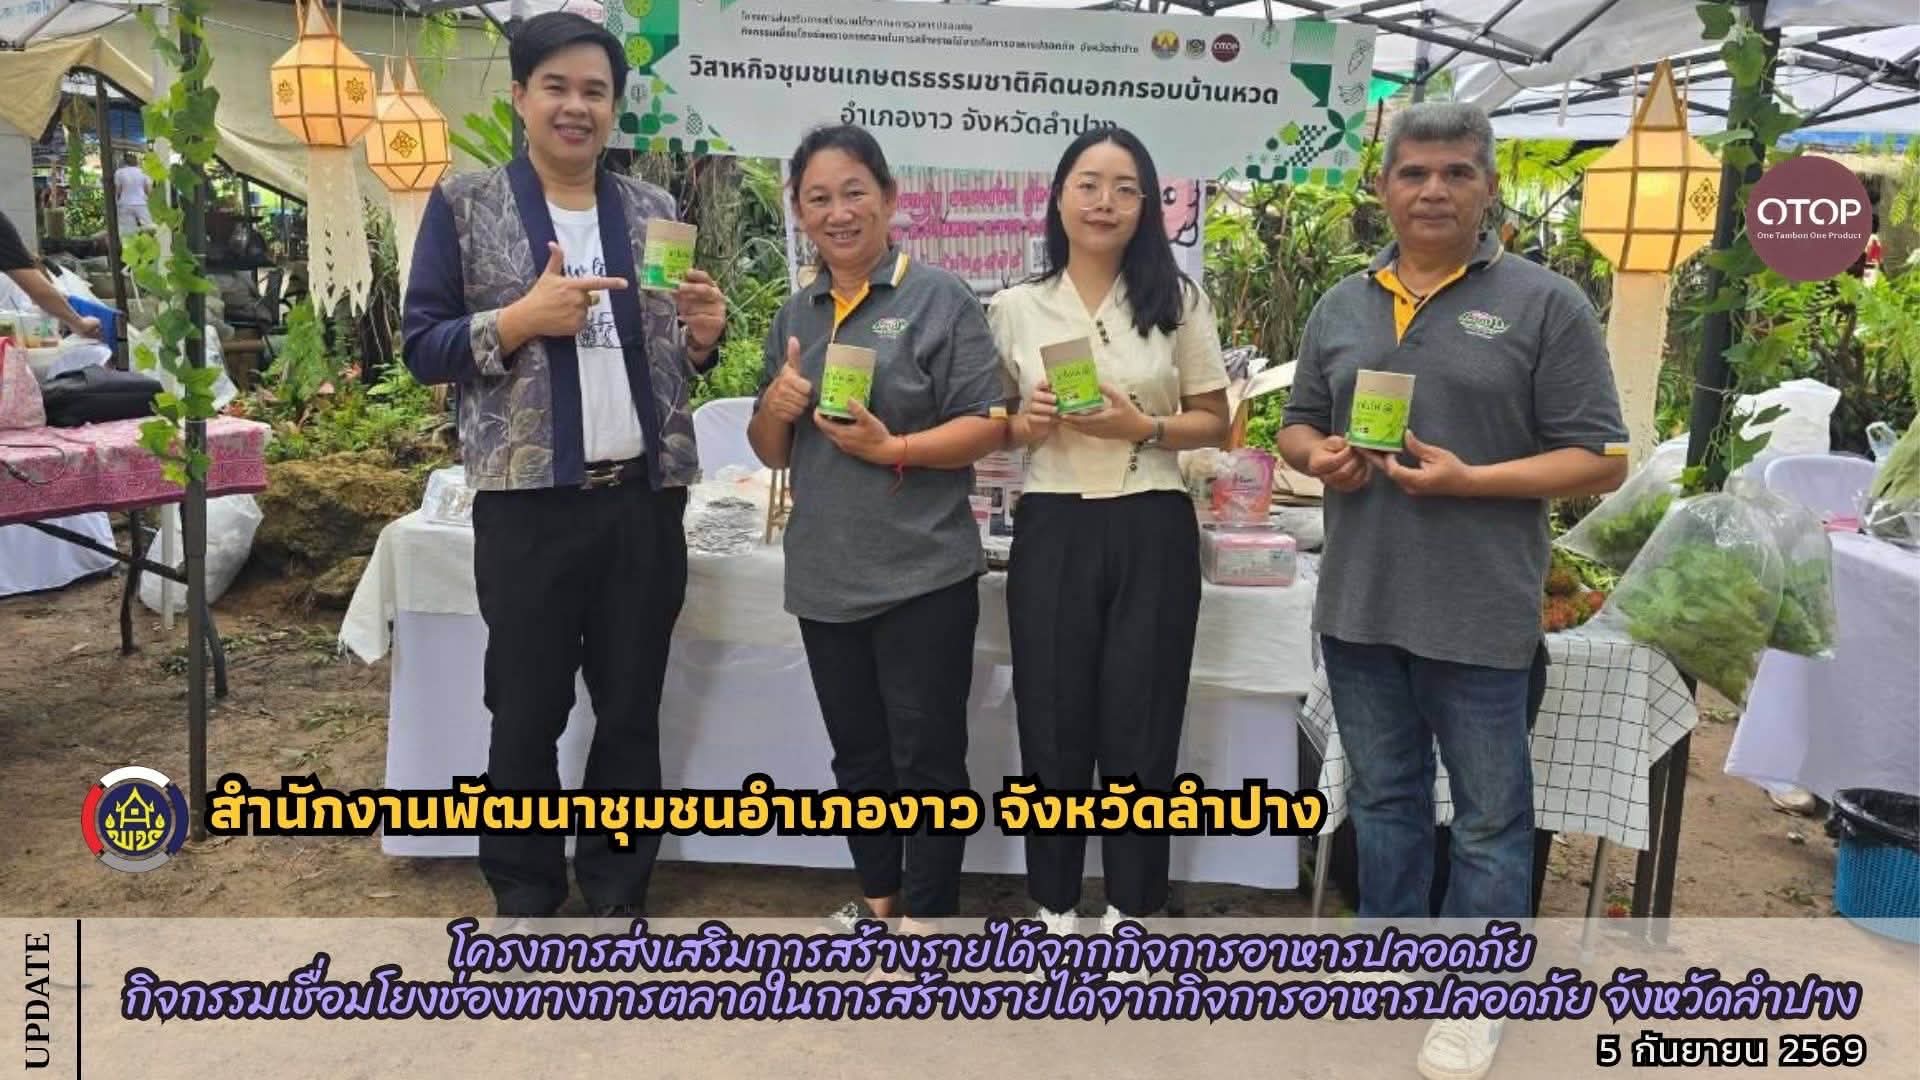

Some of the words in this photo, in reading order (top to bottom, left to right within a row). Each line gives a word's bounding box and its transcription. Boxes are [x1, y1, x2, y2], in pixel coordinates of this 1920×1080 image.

[689, 54, 1279, 104] วิสาหกิจชุมชนเกษตรธรรมชาติคิดนอกกรอบบ้านหวด
[840, 101, 953, 130] อำเภองาว
